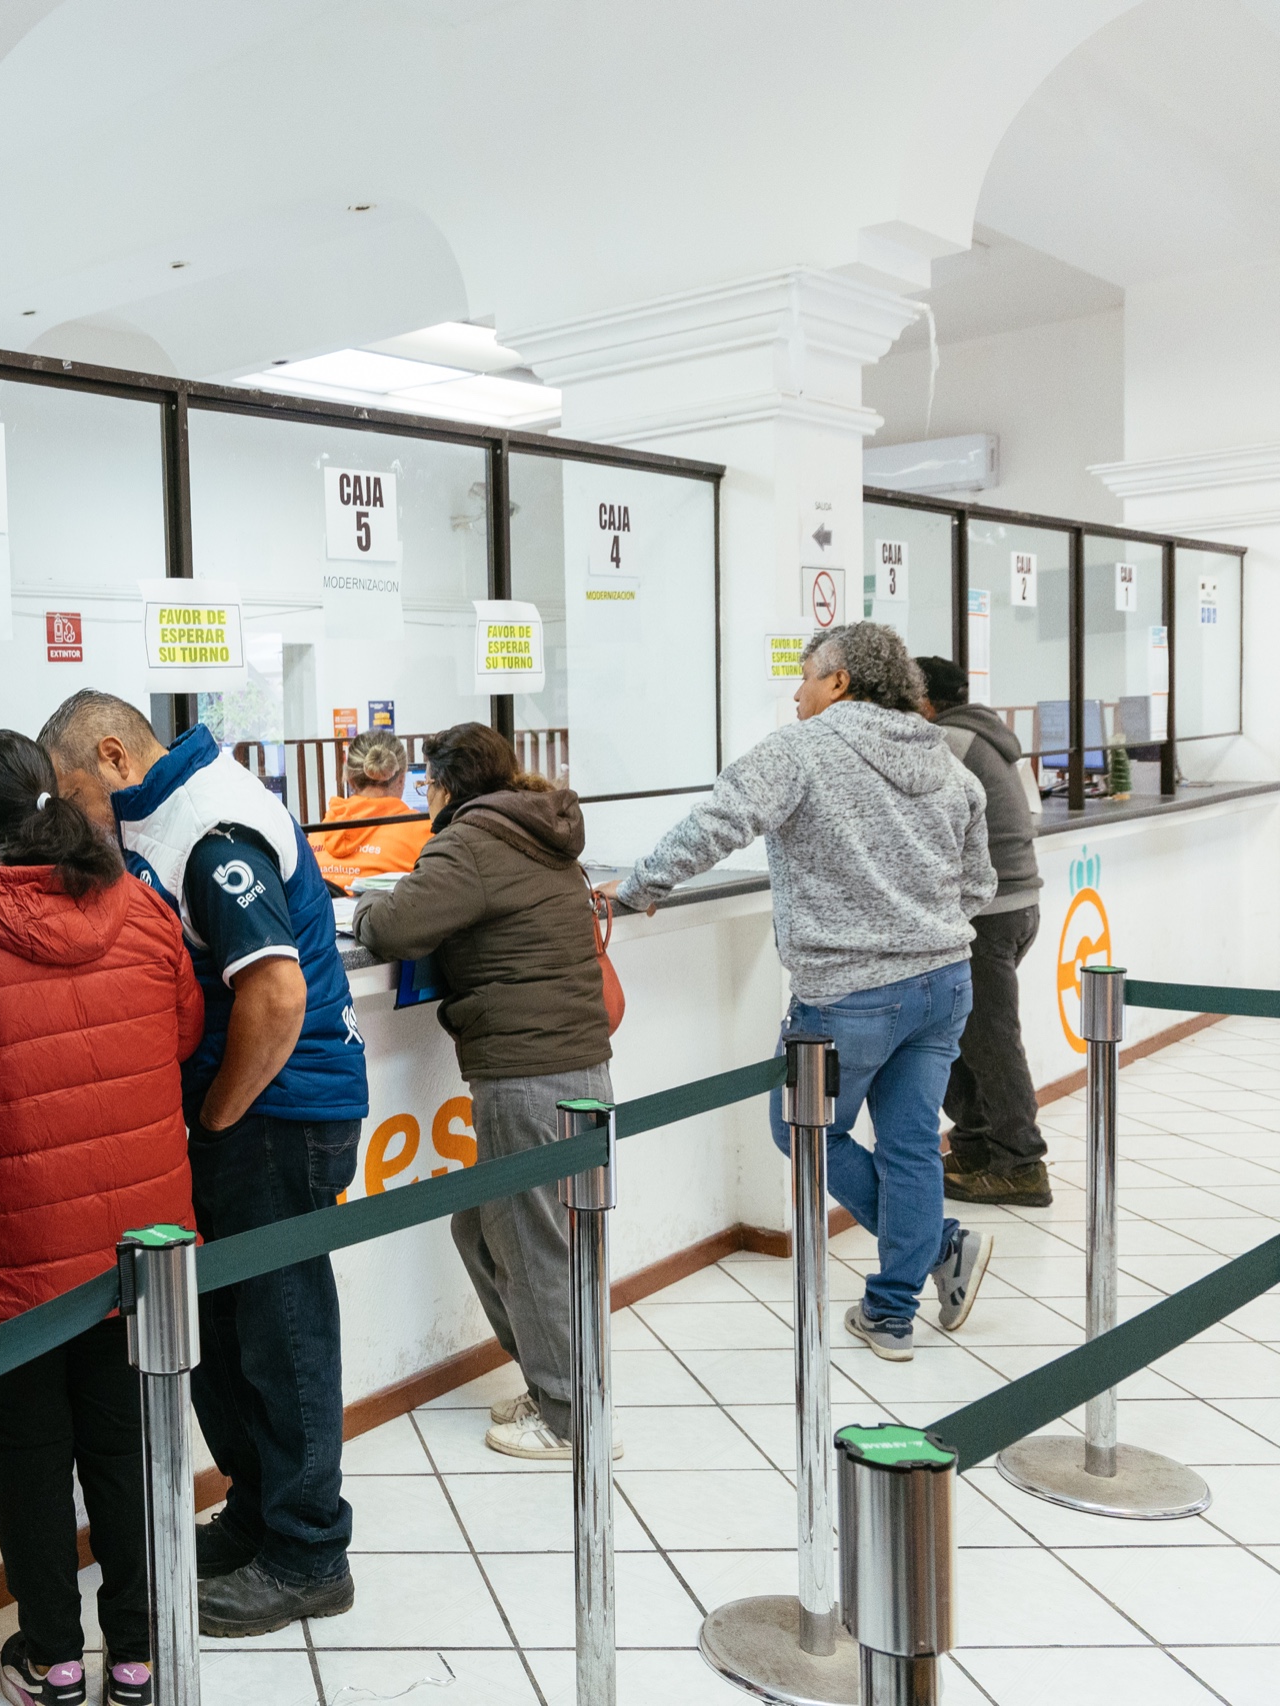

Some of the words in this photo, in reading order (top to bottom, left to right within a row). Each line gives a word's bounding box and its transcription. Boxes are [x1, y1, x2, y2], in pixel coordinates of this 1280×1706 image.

[338, 473, 384, 509] CAJA
[598, 502, 631, 533] CAJA
[355, 511, 371, 553] 5
[610, 535, 621, 569] 4
[882, 543, 902, 565] CAJA
[323, 575, 399, 593] MODERNIZACION
[889, 568, 896, 595] 3
[1021, 577, 1027, 601] 2
[586, 590, 635, 600] MODERNIZACION
[159, 609, 201, 626] FAVOR
[206, 609, 226, 626] DE
[160, 627, 225, 644] ESPERAR
[487, 625, 516, 639] FAVOR
[518, 626, 532, 640] DE
[487, 640, 530, 655] ESPERAR
[771, 638, 791, 649] FAVOR
[792, 638, 803, 649] DE
[50, 649, 81, 658] EXTINTOR
[159, 646, 176, 663] SU
[180, 646, 230, 663] TURNO
[485, 656, 498, 670] SU
[501, 655, 533, 670] TURNO
[771, 665, 780, 676] SU
[236, 880, 266, 909] Berel
